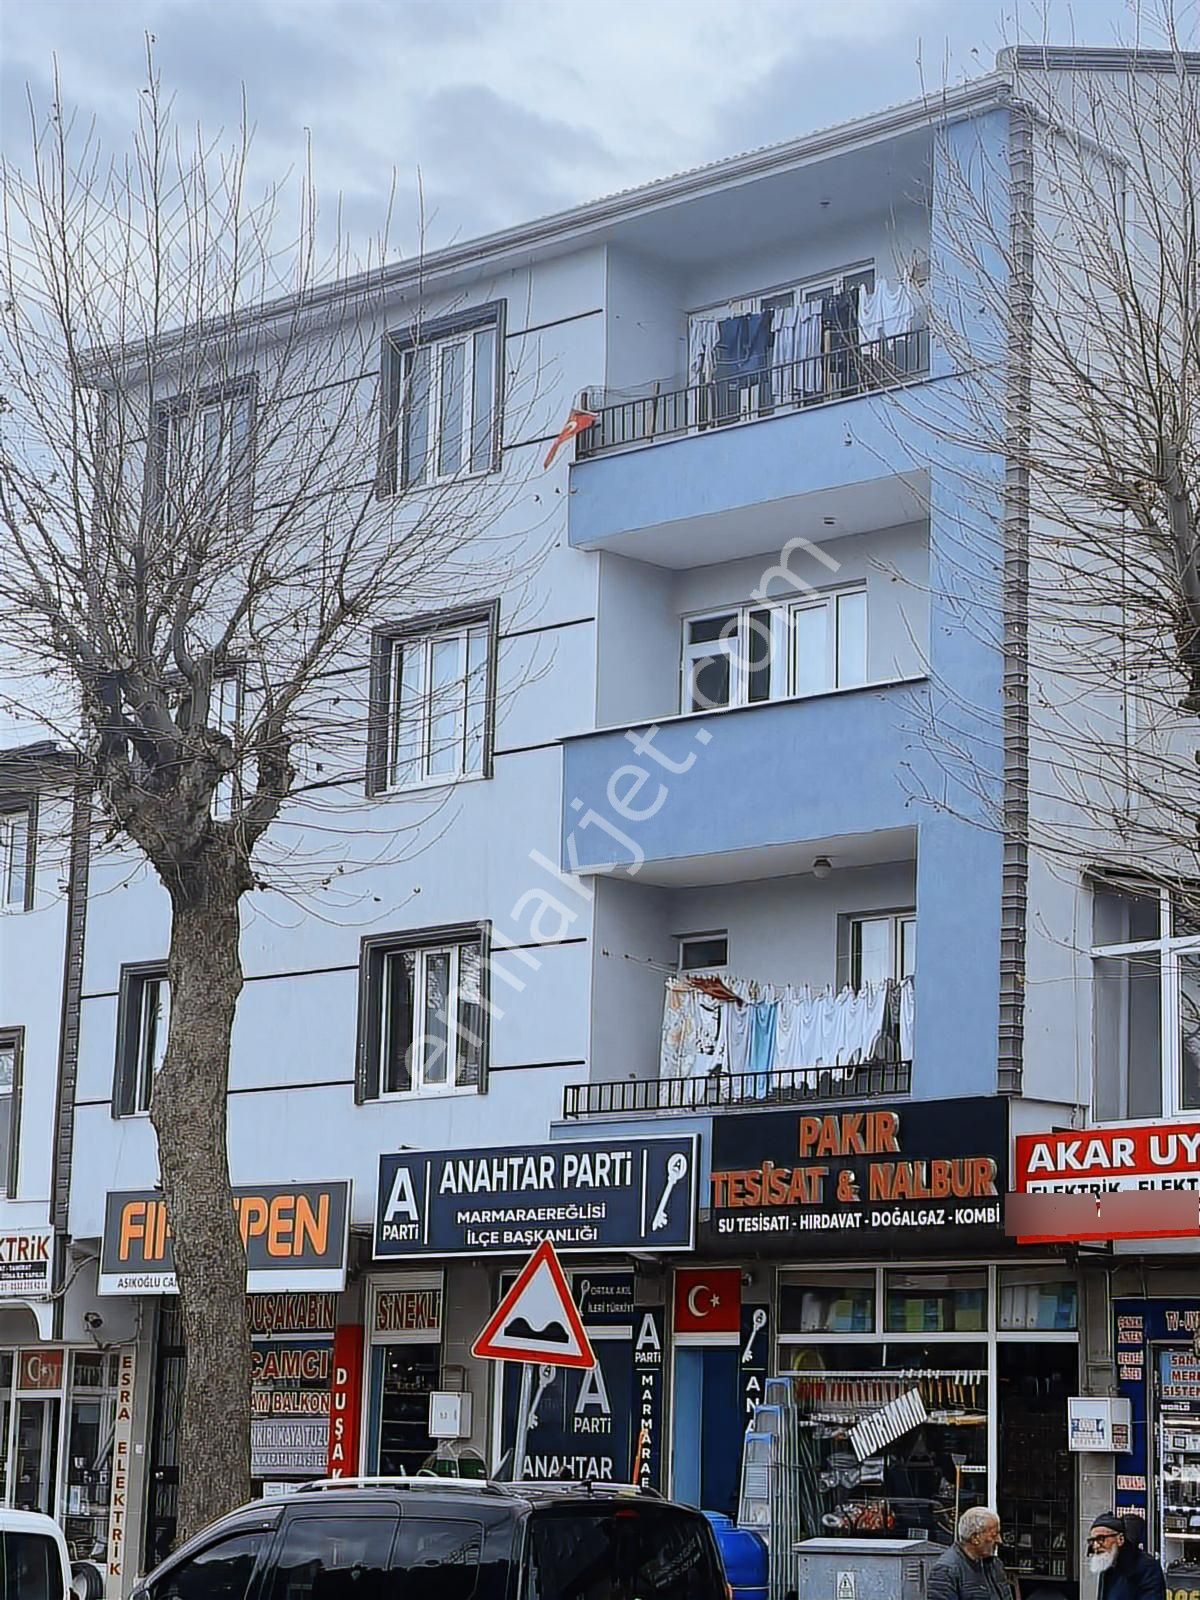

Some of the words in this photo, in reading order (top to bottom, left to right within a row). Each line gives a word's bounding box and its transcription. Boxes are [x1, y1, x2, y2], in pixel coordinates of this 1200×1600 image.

[800, 1112, 901, 1157] PAKIR
[1027, 1138, 1136, 1173] AKAR
[1150, 1133, 1200, 1166] UY
[439, 1156, 555, 1194] ANAHTAR
[563, 1151, 632, 1188] PARTİ
[710, 1160, 829, 1208] TESİSAT
[837, 1170, 861, 1202] &
[869, 1158, 998, 1200] NALBUR
[384, 1167, 419, 1222] A
[457, 1202, 606, 1224] MARMARAEREĞLİSİ
[119, 1193, 330, 1261] FIPEN
[382, 1223, 419, 1240] PARTİ
[467, 1229, 499, 1247] İLÇE
[503, 1225, 597, 1247] BAŞKANLIĞI
[718, 1218, 735, 1233] SU
[736, 1212, 790, 1232] TESİSATI
[800, 1213, 862, 1229] HIRDAVAT
[872, 1207, 945, 1227] DOĞALGAZ
[955, 1203, 1000, 1224] KOMBİ
[636, 1313, 660, 1350] A
[251, 1350, 329, 1380] CAMCI
[117, 1355, 132, 1420] ESRA
[272, 1391, 331, 1415] BALKON
[575, 1360, 611, 1414] A
[640, 1374, 654, 1489] MARMARAE
[522, 1455, 613, 1480] ANAHTAR
[109, 1441, 128, 1576] ELEKTRİK
